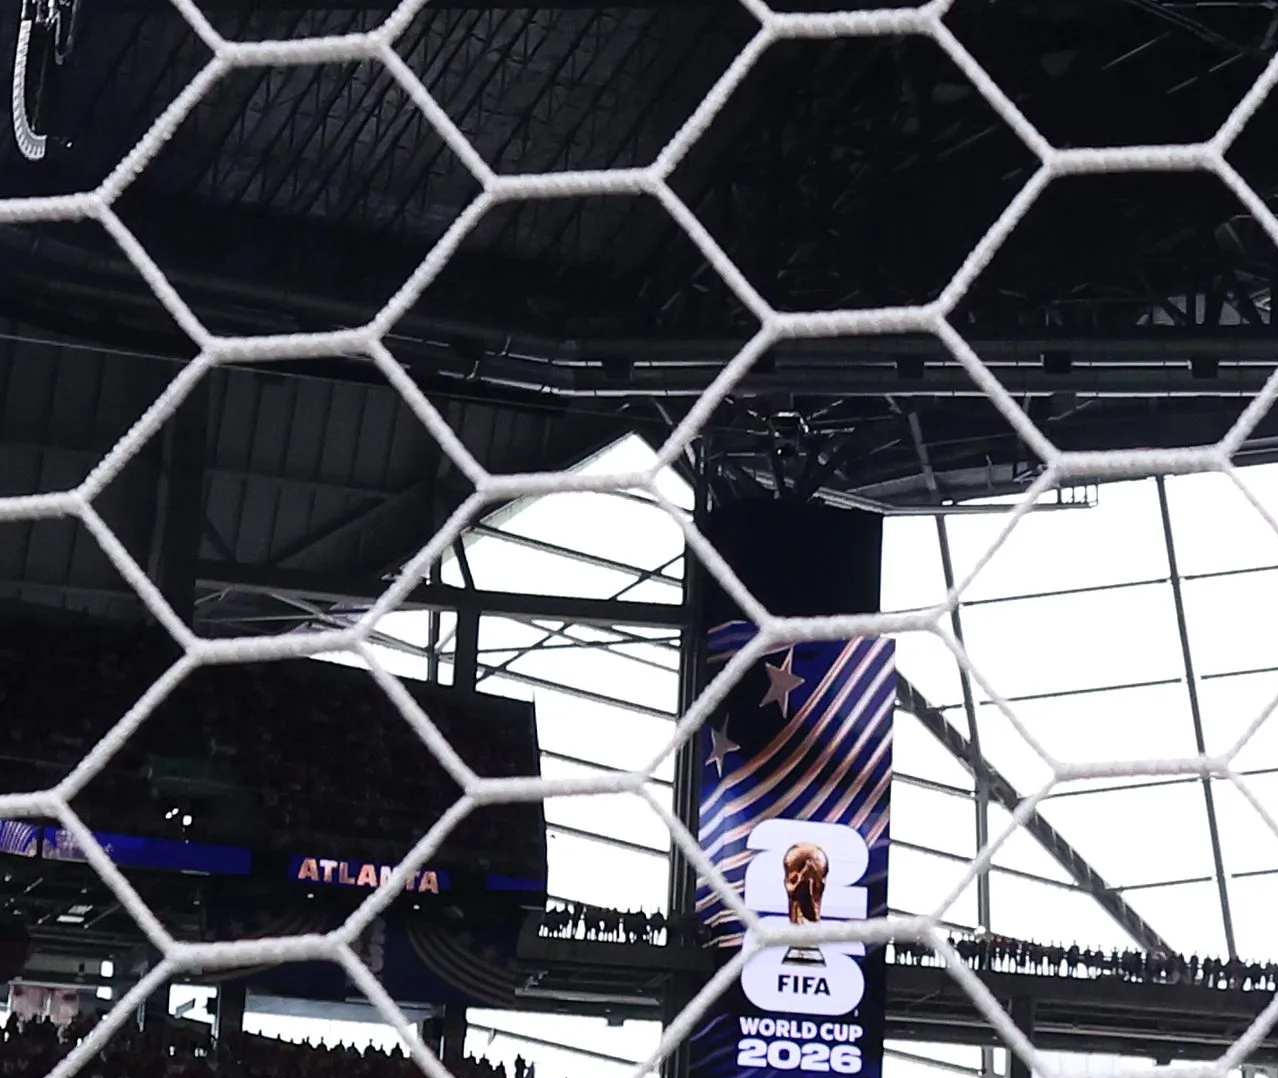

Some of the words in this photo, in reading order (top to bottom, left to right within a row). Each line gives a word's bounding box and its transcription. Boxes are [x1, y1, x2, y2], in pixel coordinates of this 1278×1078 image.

[777, 974, 831, 997] FIFA
[740, 1016, 817, 1040] WORLD
[820, 1022, 864, 1043] CUP
[737, 1038, 863, 1074] 2026
